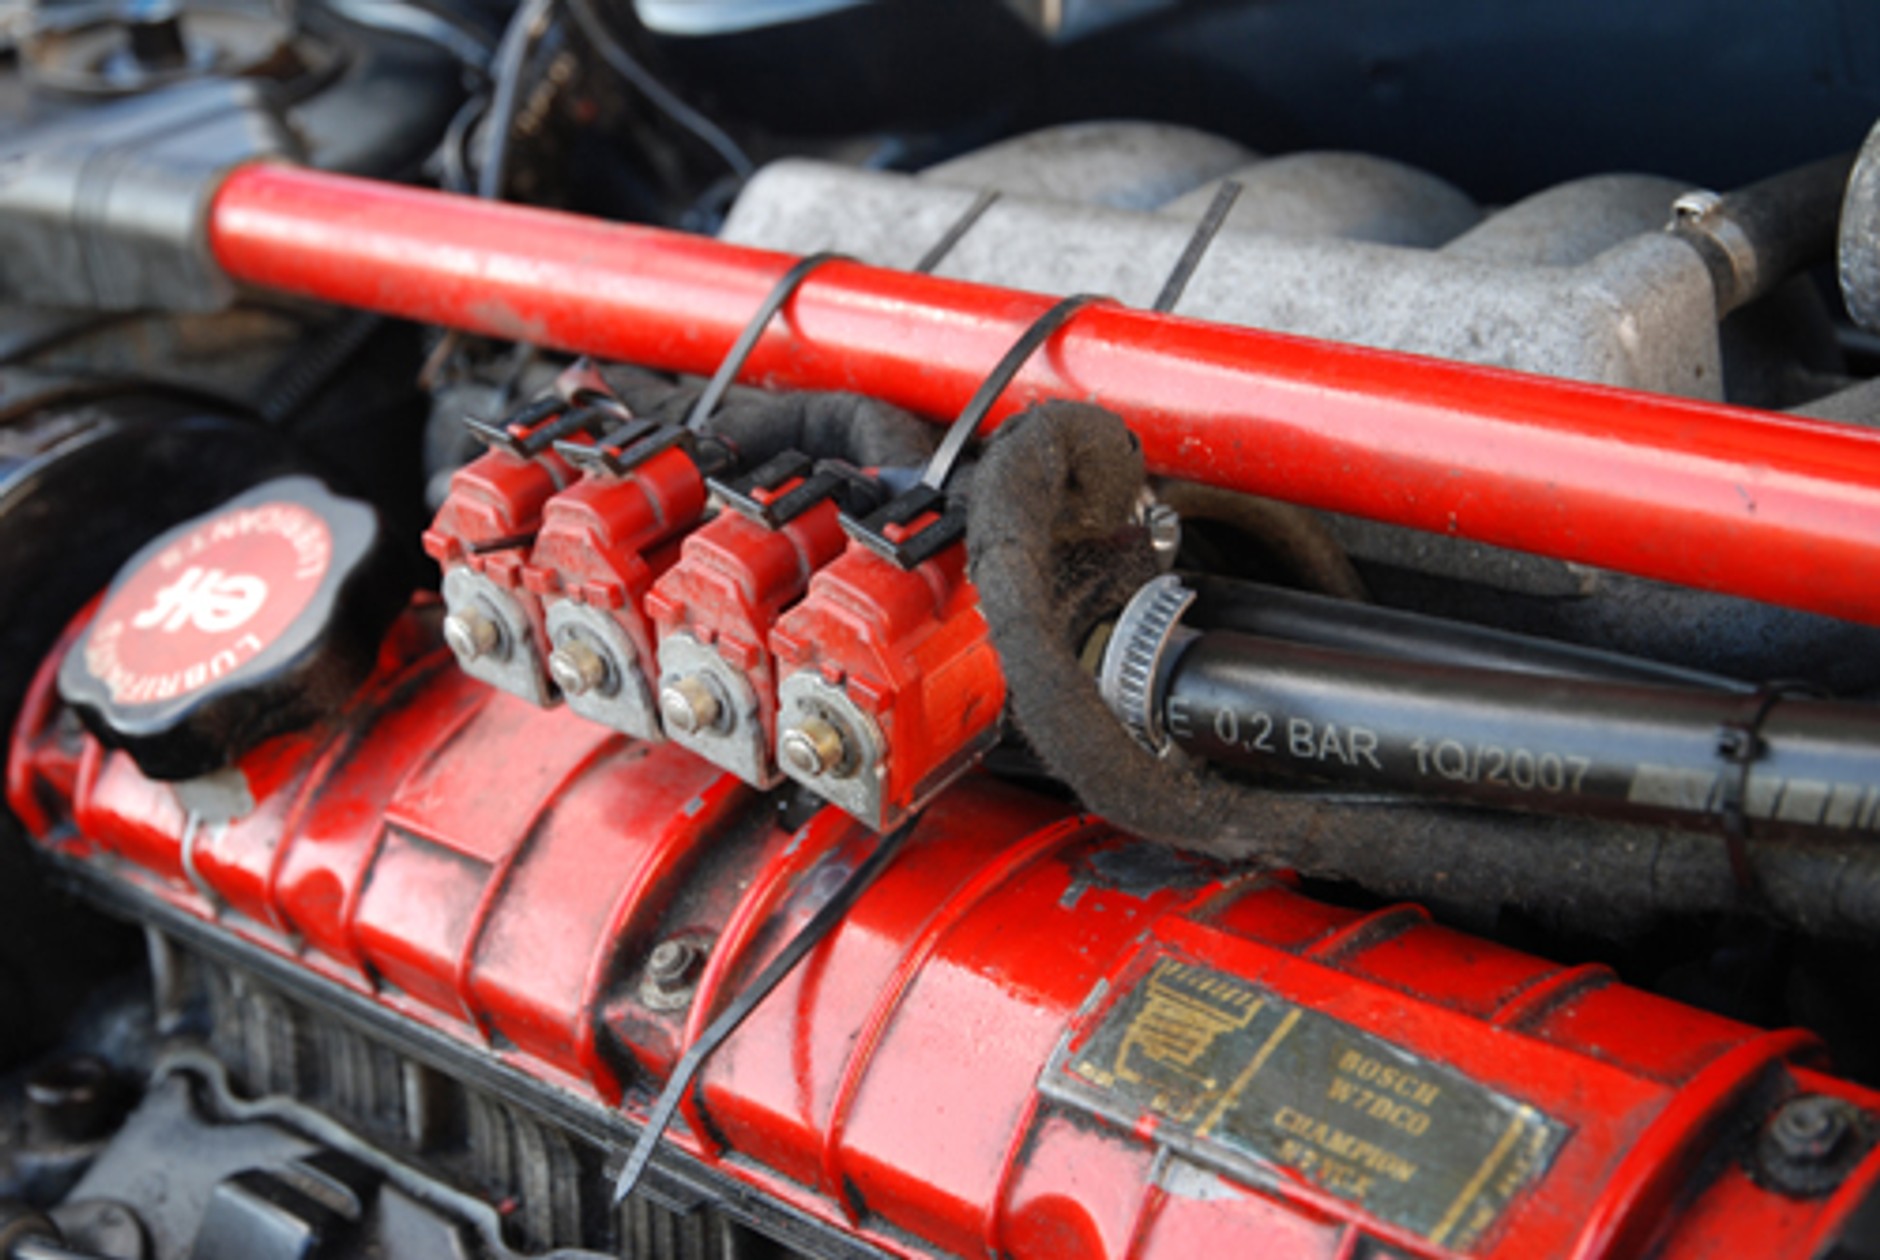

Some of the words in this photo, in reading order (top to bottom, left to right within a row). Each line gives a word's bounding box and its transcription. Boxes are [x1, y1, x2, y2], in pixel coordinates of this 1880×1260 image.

[132, 566, 267, 632] elf
[1288, 717, 1383, 772] BAR
[1409, 736, 1591, 796] 1Q/2007
[1338, 1049, 1441, 1107] BOSCH
[1273, 1105, 1418, 1183] CHAMPION
